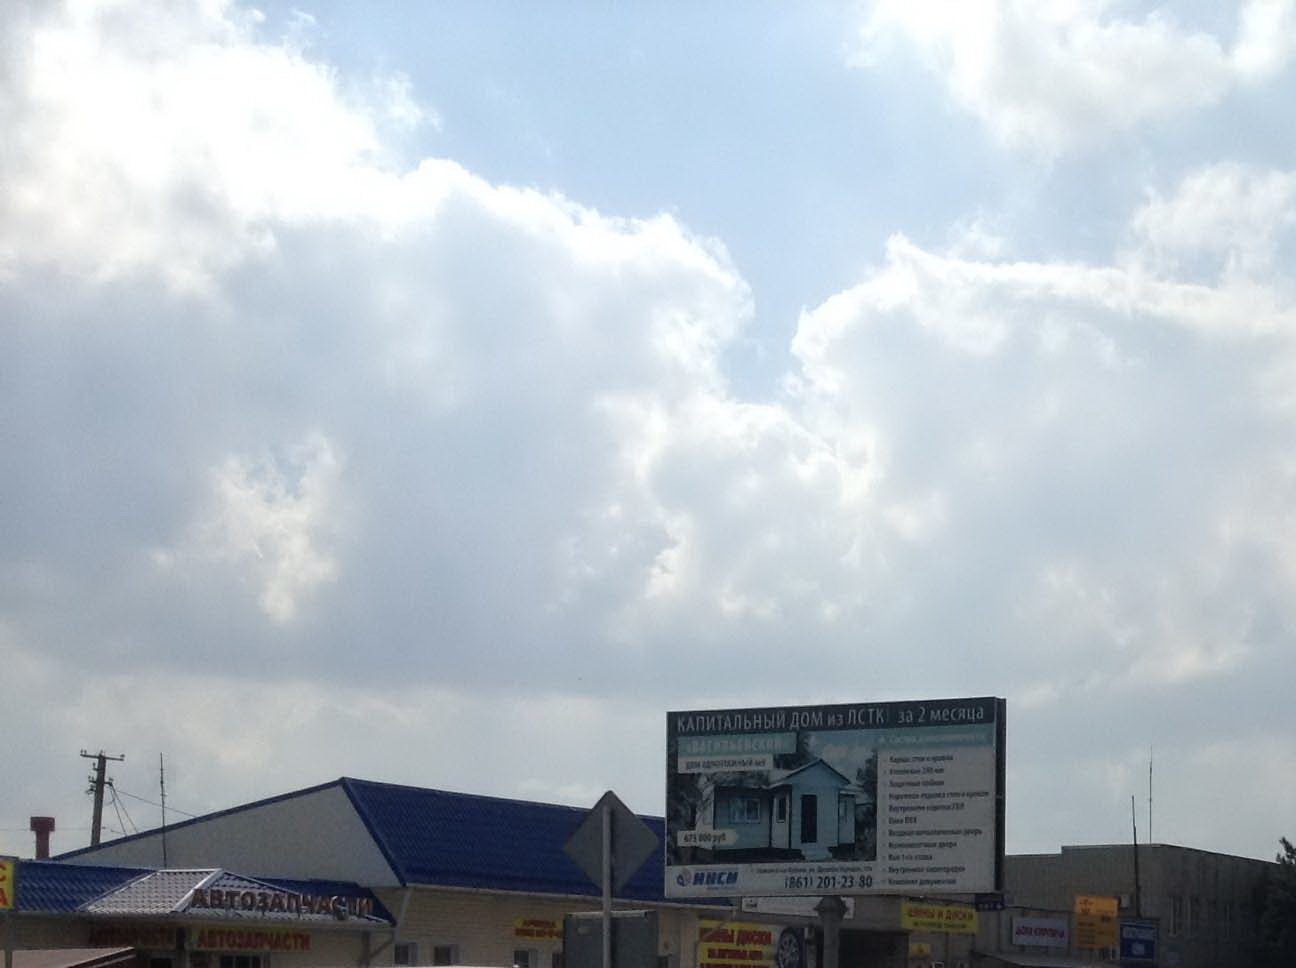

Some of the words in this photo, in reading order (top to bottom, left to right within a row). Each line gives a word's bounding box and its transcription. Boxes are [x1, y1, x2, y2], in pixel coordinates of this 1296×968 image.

[677, 710, 786, 733] КАПИТАЛЬНЫЙ
[789, 710, 823, 731] ДОМ
[827, 713, 843, 727] из
[847, 707, 885, 725] ЛСТК
[898, 710, 914, 722] за
[917, 706, 926, 721] 2
[930, 705, 984, 722] месяца
[816, 874, 873, 889] 201-23-80
[191, 886, 372, 917] АВТОЗАПЧАСТИ
[197, 928, 311, 951] АВТОЗАПЧАСТИ
